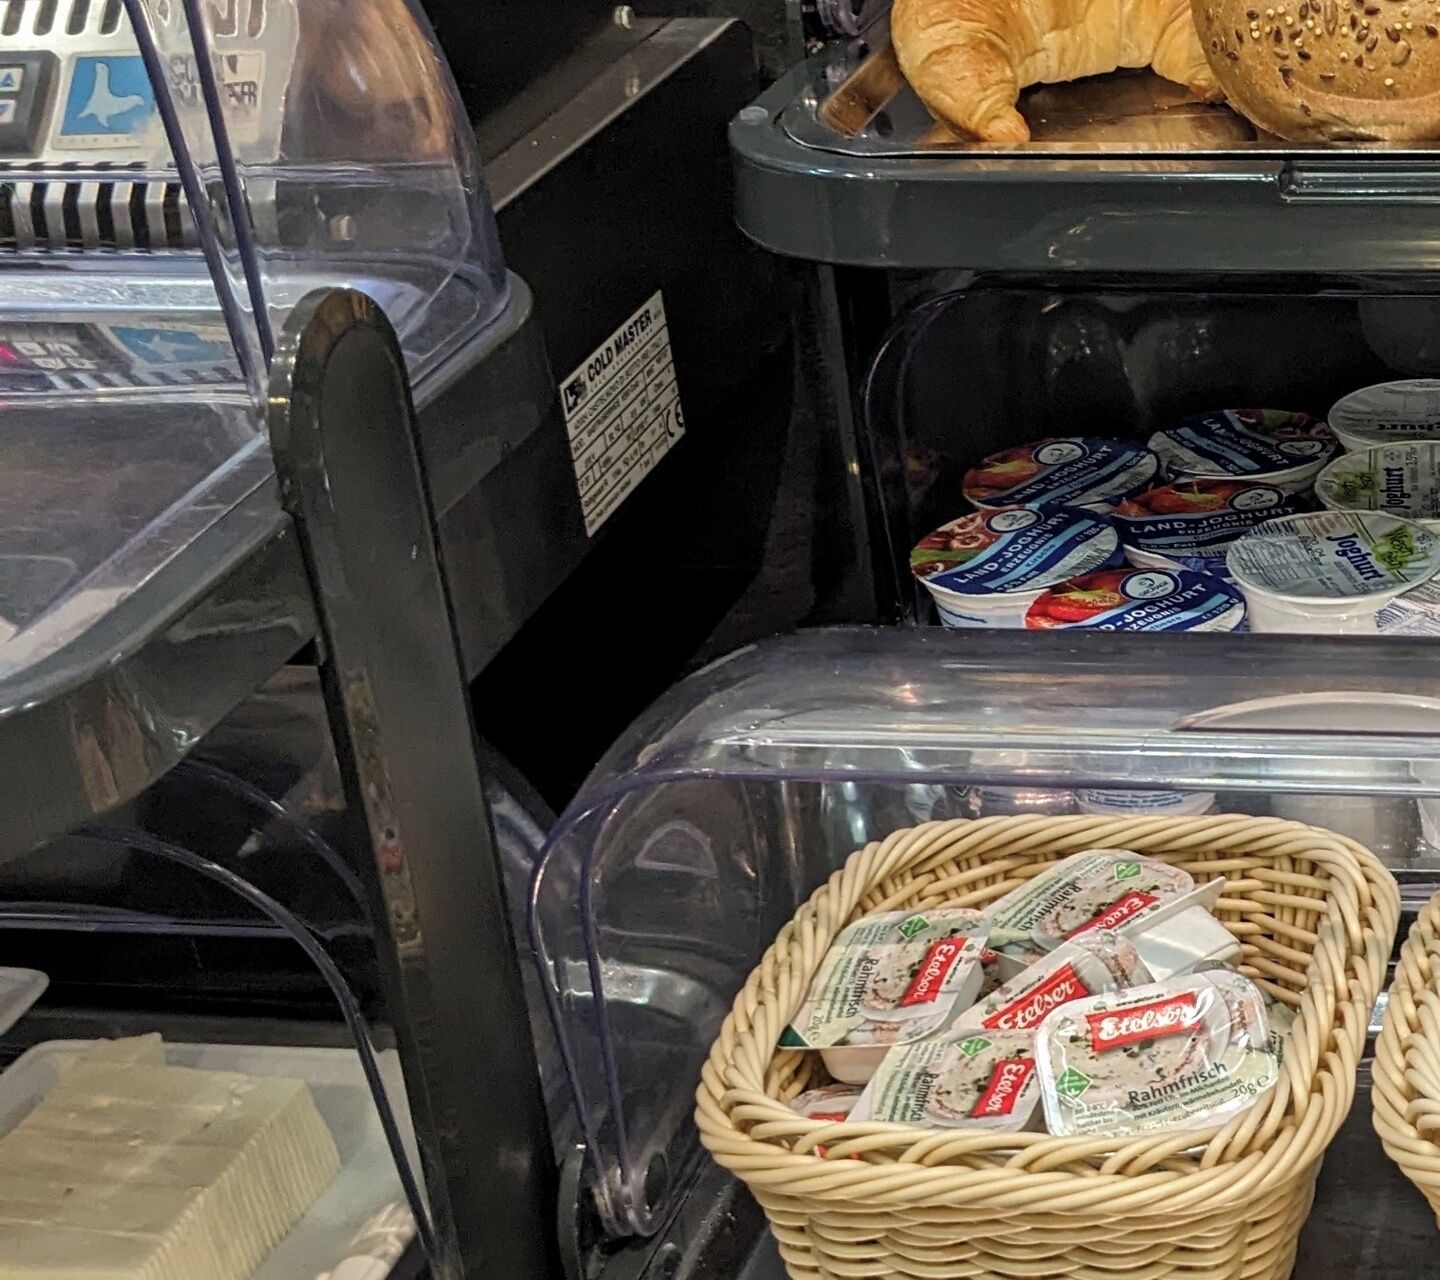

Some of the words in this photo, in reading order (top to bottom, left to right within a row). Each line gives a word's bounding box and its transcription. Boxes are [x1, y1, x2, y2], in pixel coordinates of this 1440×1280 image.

[588, 346, 614, 383] COLD
[614, 309, 653, 357] MASTER
[1380, 467, 1412, 509] Joghurt
[1130, 506, 1295, 534] LAND-JOGHURT
[953, 513, 1069, 584] LAND-JOGHURT
[1000, 533, 1054, 574] ERZEUGNIS
[1326, 532, 1385, 582] Joghurt
[1020, 882, 1083, 932] Rahmfrisch
[844, 958, 879, 1018] Rahmfrisch
[913, 942, 956, 998] Etelser
[998, 981, 1076, 1030] Etelser
[1099, 998, 1203, 1041] Etelser
[912, 1072, 940, 1121] Rahmfrisch
[985, 1063, 1026, 1113] Etelser
[1128, 1061, 1228, 1105] Rahmfrisch
[1182, 1078, 1243, 1107] wärmebehandelt
[1232, 1081, 1258, 1099] 20g
